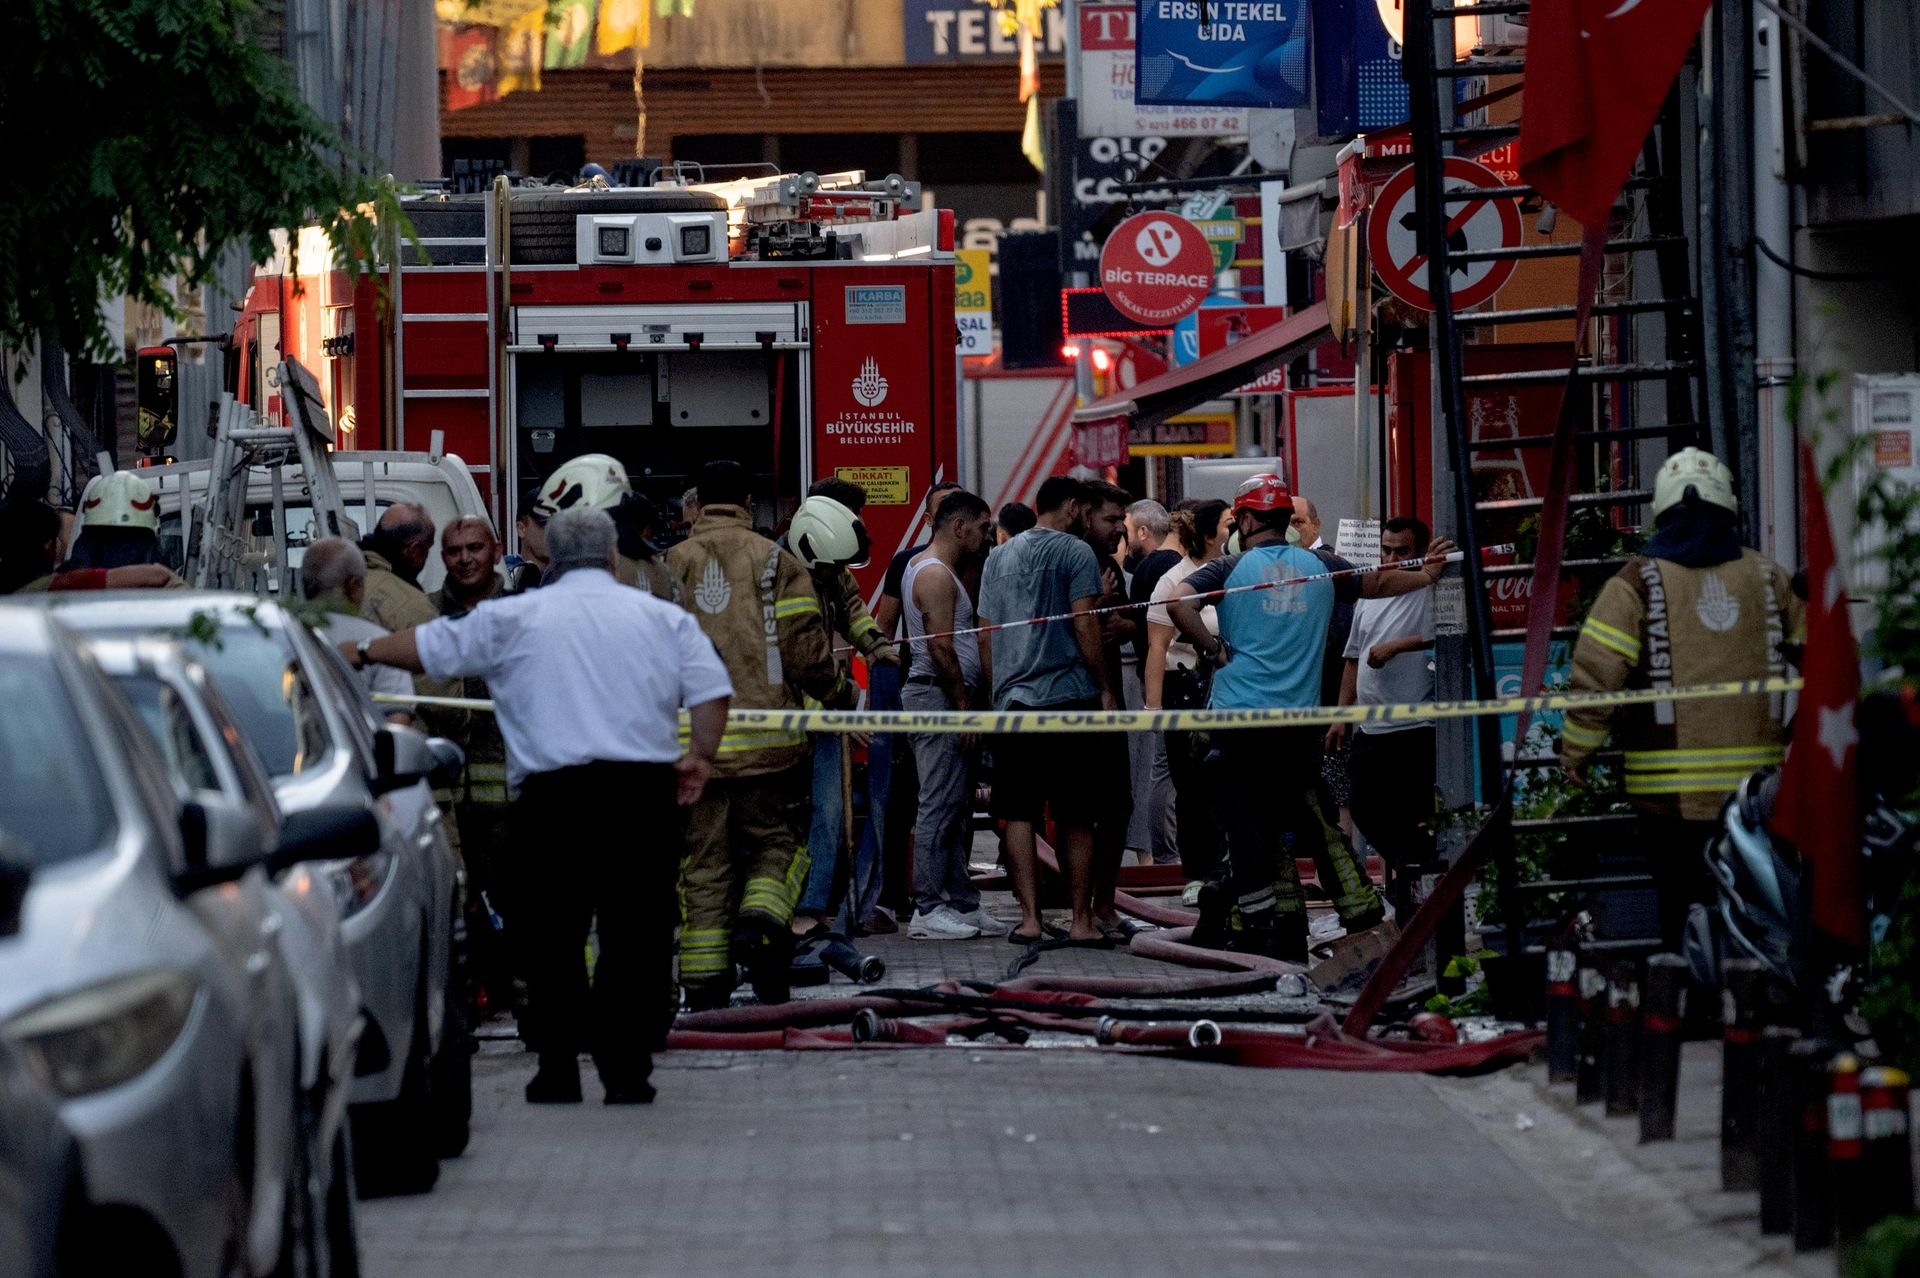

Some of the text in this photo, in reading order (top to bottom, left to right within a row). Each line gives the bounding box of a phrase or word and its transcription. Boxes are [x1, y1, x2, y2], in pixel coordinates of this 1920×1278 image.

[1158, 1, 1287, 21] ERSN TEKEL
[1197, 23, 1247, 41] GIDA
[1171, 117, 1198, 129] 466
[1201, 117, 1217, 129] 07
[1222, 117, 1239, 129] 42
[1136, 271, 1208, 288] TERRACE
[859, 291, 902, 301] KARBA
[840, 412, 901, 421] İSTANBUL
[826, 420, 915, 435] BÜYÜKŞEHİR
[840, 435, 902, 444] BELEDİYESİ
